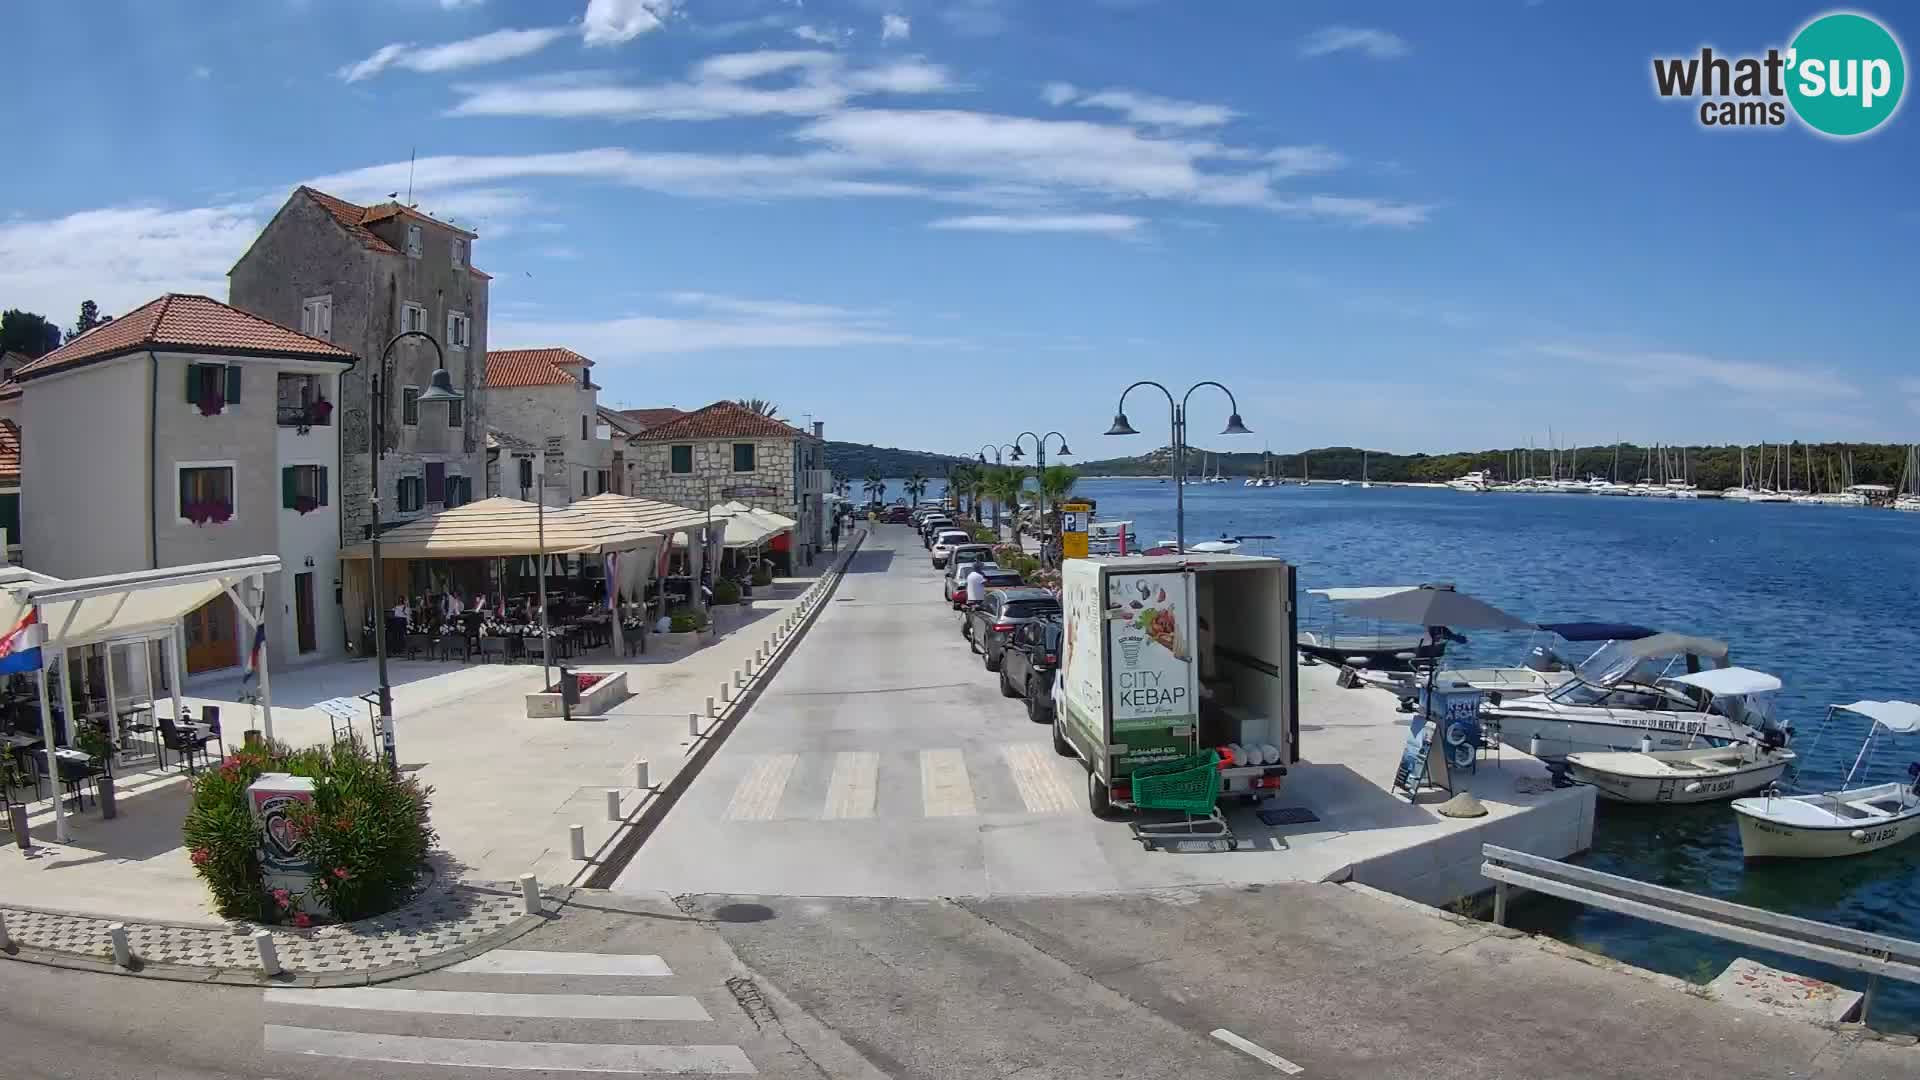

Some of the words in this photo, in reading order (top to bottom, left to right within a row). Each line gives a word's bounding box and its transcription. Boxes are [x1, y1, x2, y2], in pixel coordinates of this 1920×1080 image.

[1064, 514, 1075, 531] P
[1119, 670, 1162, 689] CITY
[1120, 687, 1186, 707] KEBAP
[1658, 720, 1679, 731] RENT
